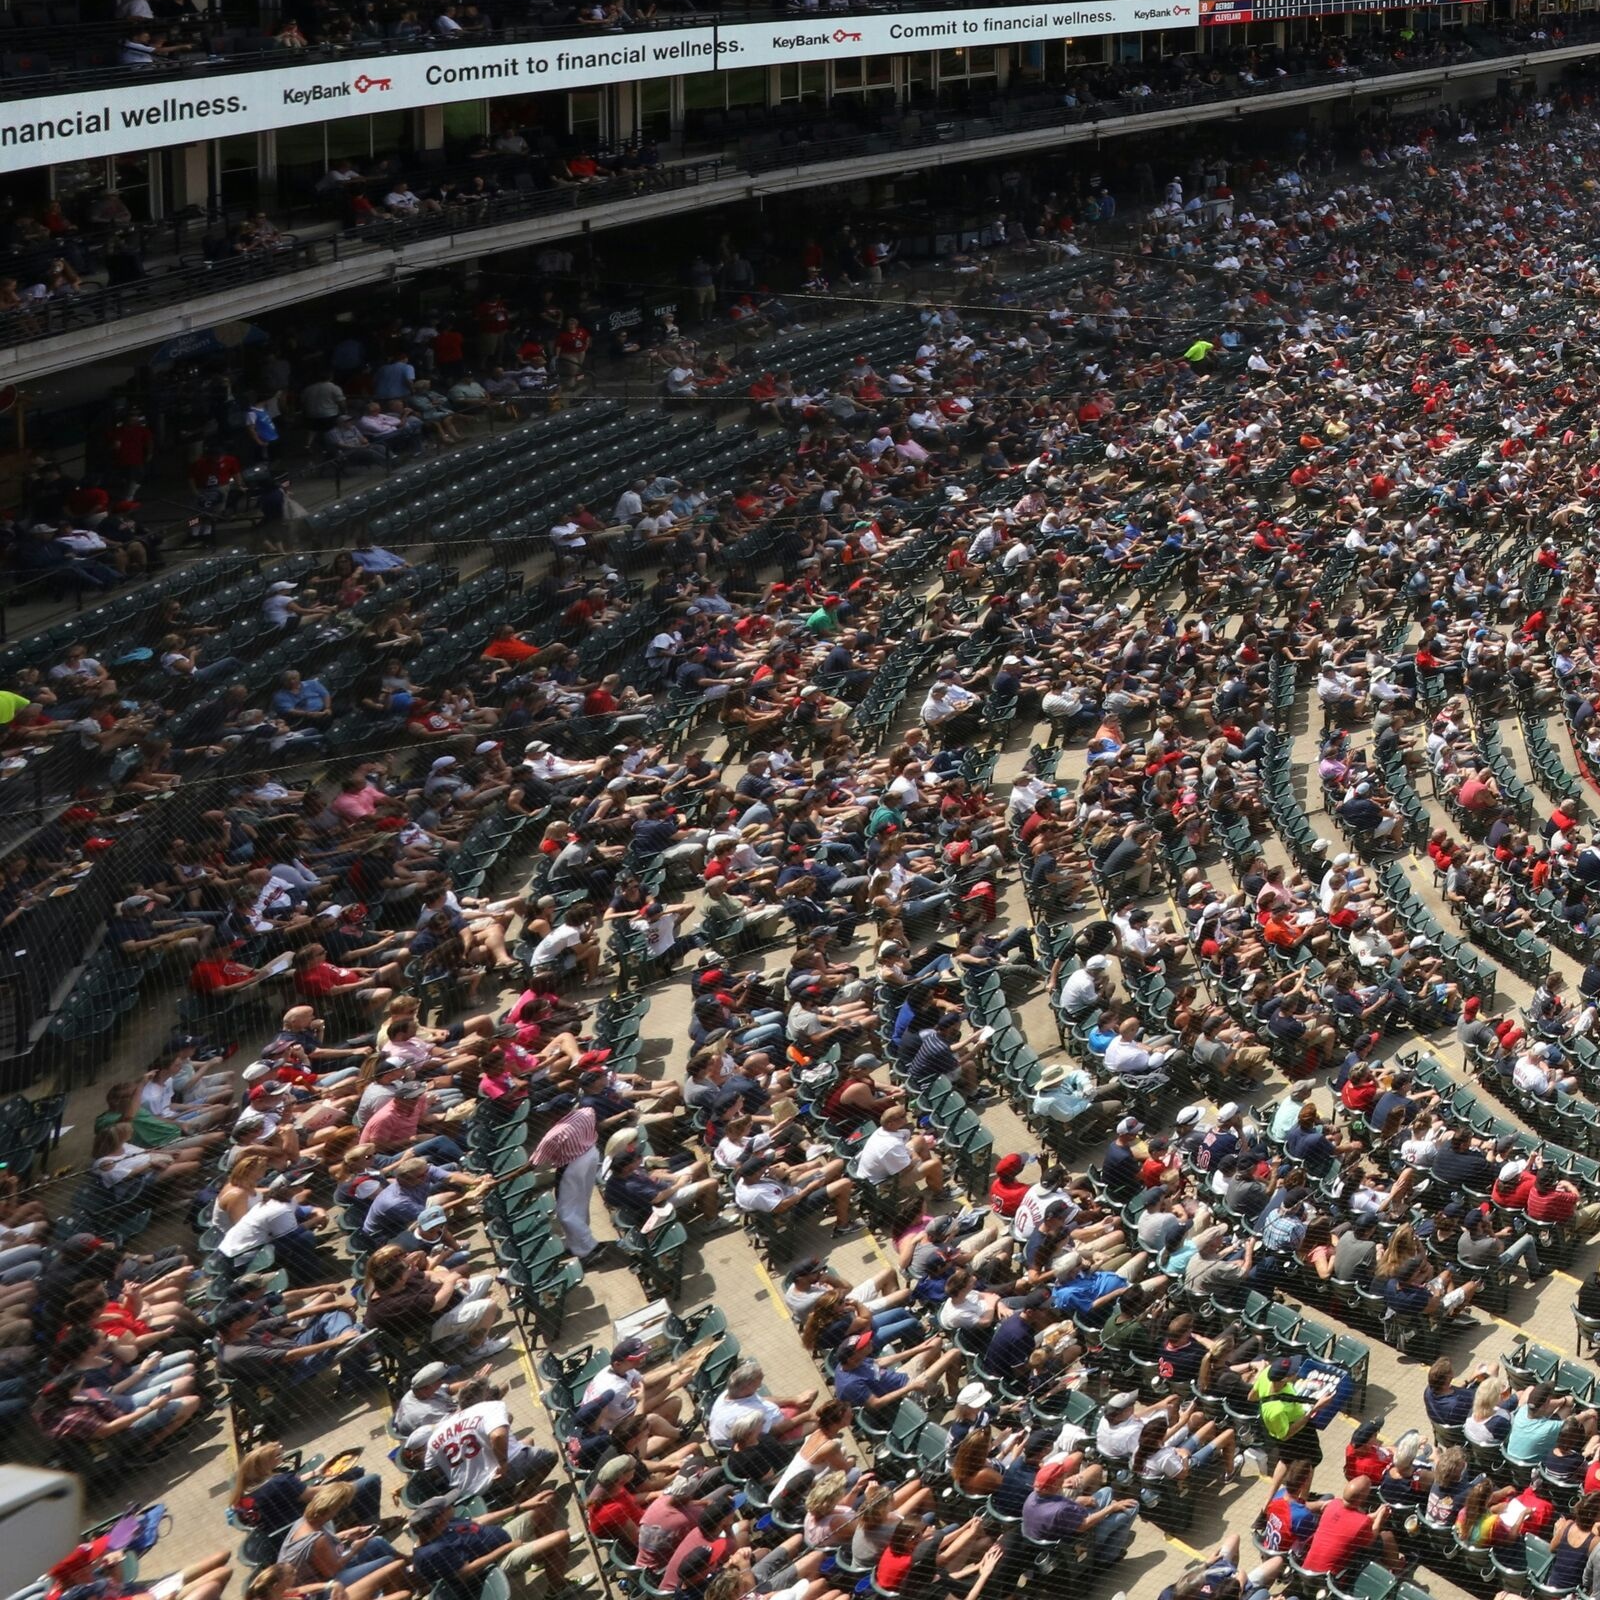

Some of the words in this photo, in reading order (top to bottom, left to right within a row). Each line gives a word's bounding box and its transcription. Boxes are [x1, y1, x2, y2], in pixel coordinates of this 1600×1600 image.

[890, 23, 957, 40] Commit
[963, 20, 979, 34] to
[983, 13, 1049, 33] financial
[1052, 10, 1117, 27] wellness.
[1134, 6, 1172, 21] KeyBank
[772, 33, 830, 51] KeyBank
[426, 57, 519, 86] Commit
[526, 56, 549, 74] to
[557, 44, 646, 72] financial
[653, 38, 745, 62] wellness.
[283, 81, 351, 107] KeyBank
[121, 95, 248, 129] wellness.
[443, 1434, 481, 1468] 23
